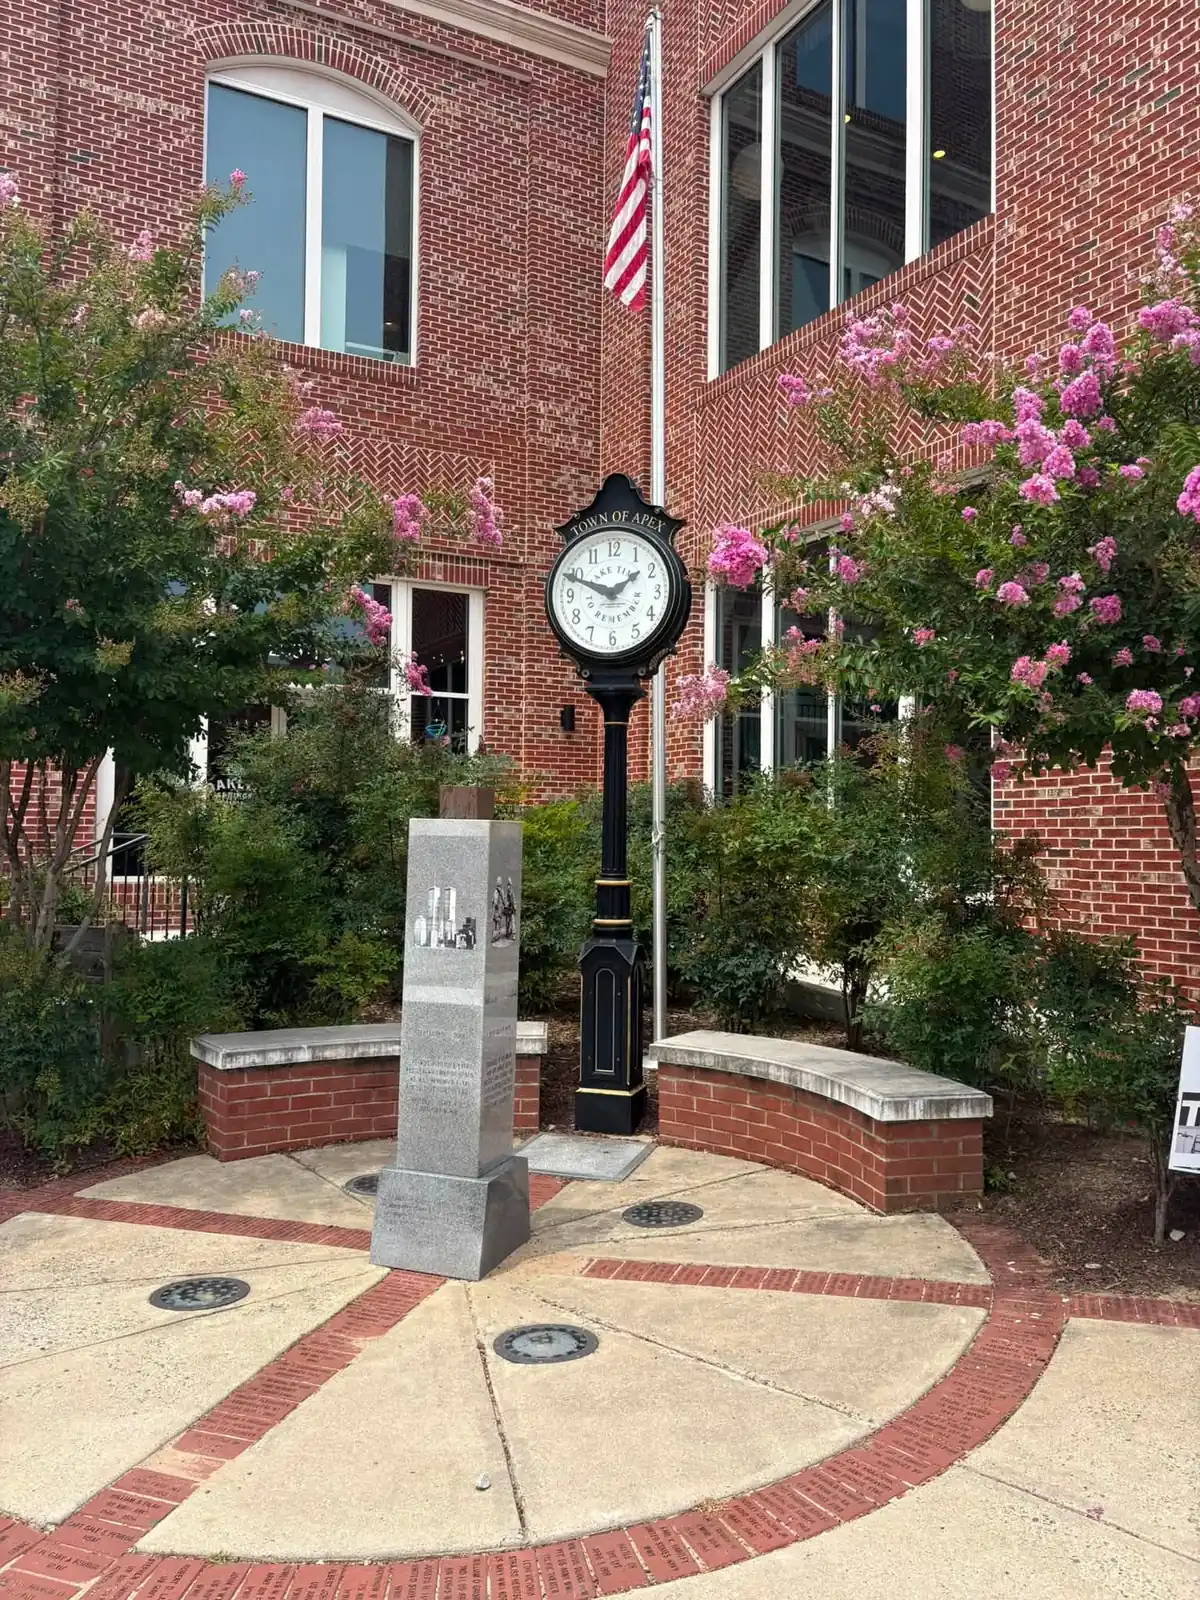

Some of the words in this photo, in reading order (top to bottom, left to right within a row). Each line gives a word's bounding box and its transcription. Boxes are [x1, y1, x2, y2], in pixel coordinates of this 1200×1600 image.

[570, 512, 608, 536] TOWN
[612, 510, 630, 522] OF
[632, 511, 666, 533] APEX
[588, 548, 598, 564] 11
[608, 541, 621, 557] 12
[633, 546, 639, 562] 1
[647, 562, 656, 578] 2
[566, 588, 575, 604] 9
[654, 584, 661, 600] 3
[594, 592, 642, 623] REMEMBER
[646, 604, 655, 621] 4
[571, 608, 581, 624] 8
[585, 626, 594, 642] 7
[608, 630, 617, 646] 6
[631, 622, 641, 639] 5
